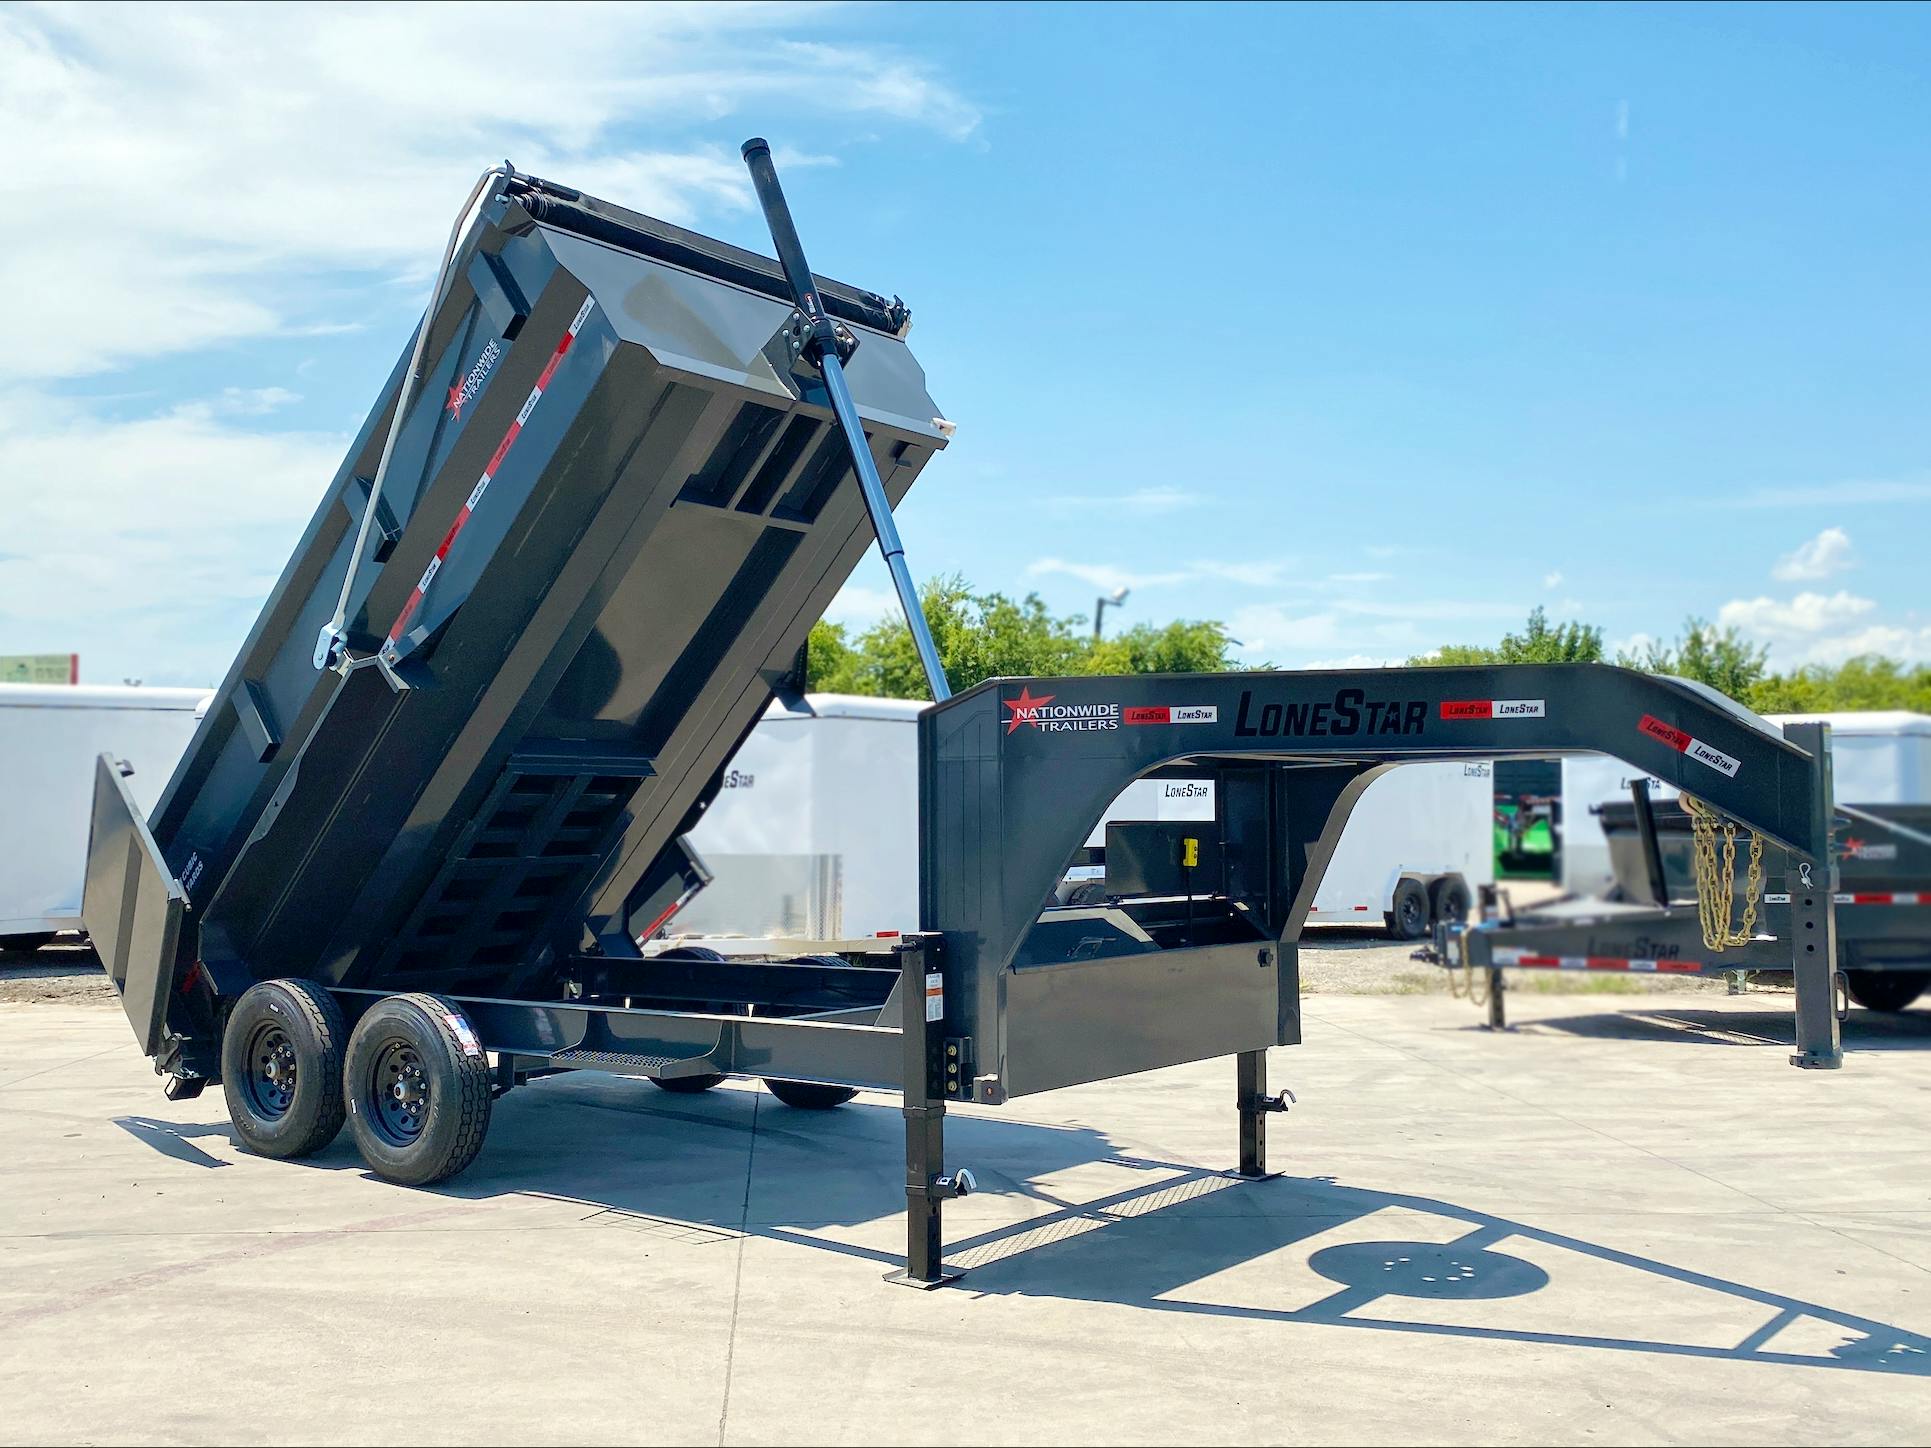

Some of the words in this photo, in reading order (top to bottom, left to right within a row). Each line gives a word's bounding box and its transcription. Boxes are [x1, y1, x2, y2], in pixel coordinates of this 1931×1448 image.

[453, 337, 497, 409] NATIONWIDE
[467, 346, 501, 400] TRAILERS
[1016, 703, 1119, 719] NATIONWIDE
[1039, 719, 1118, 732] TRAILERS
